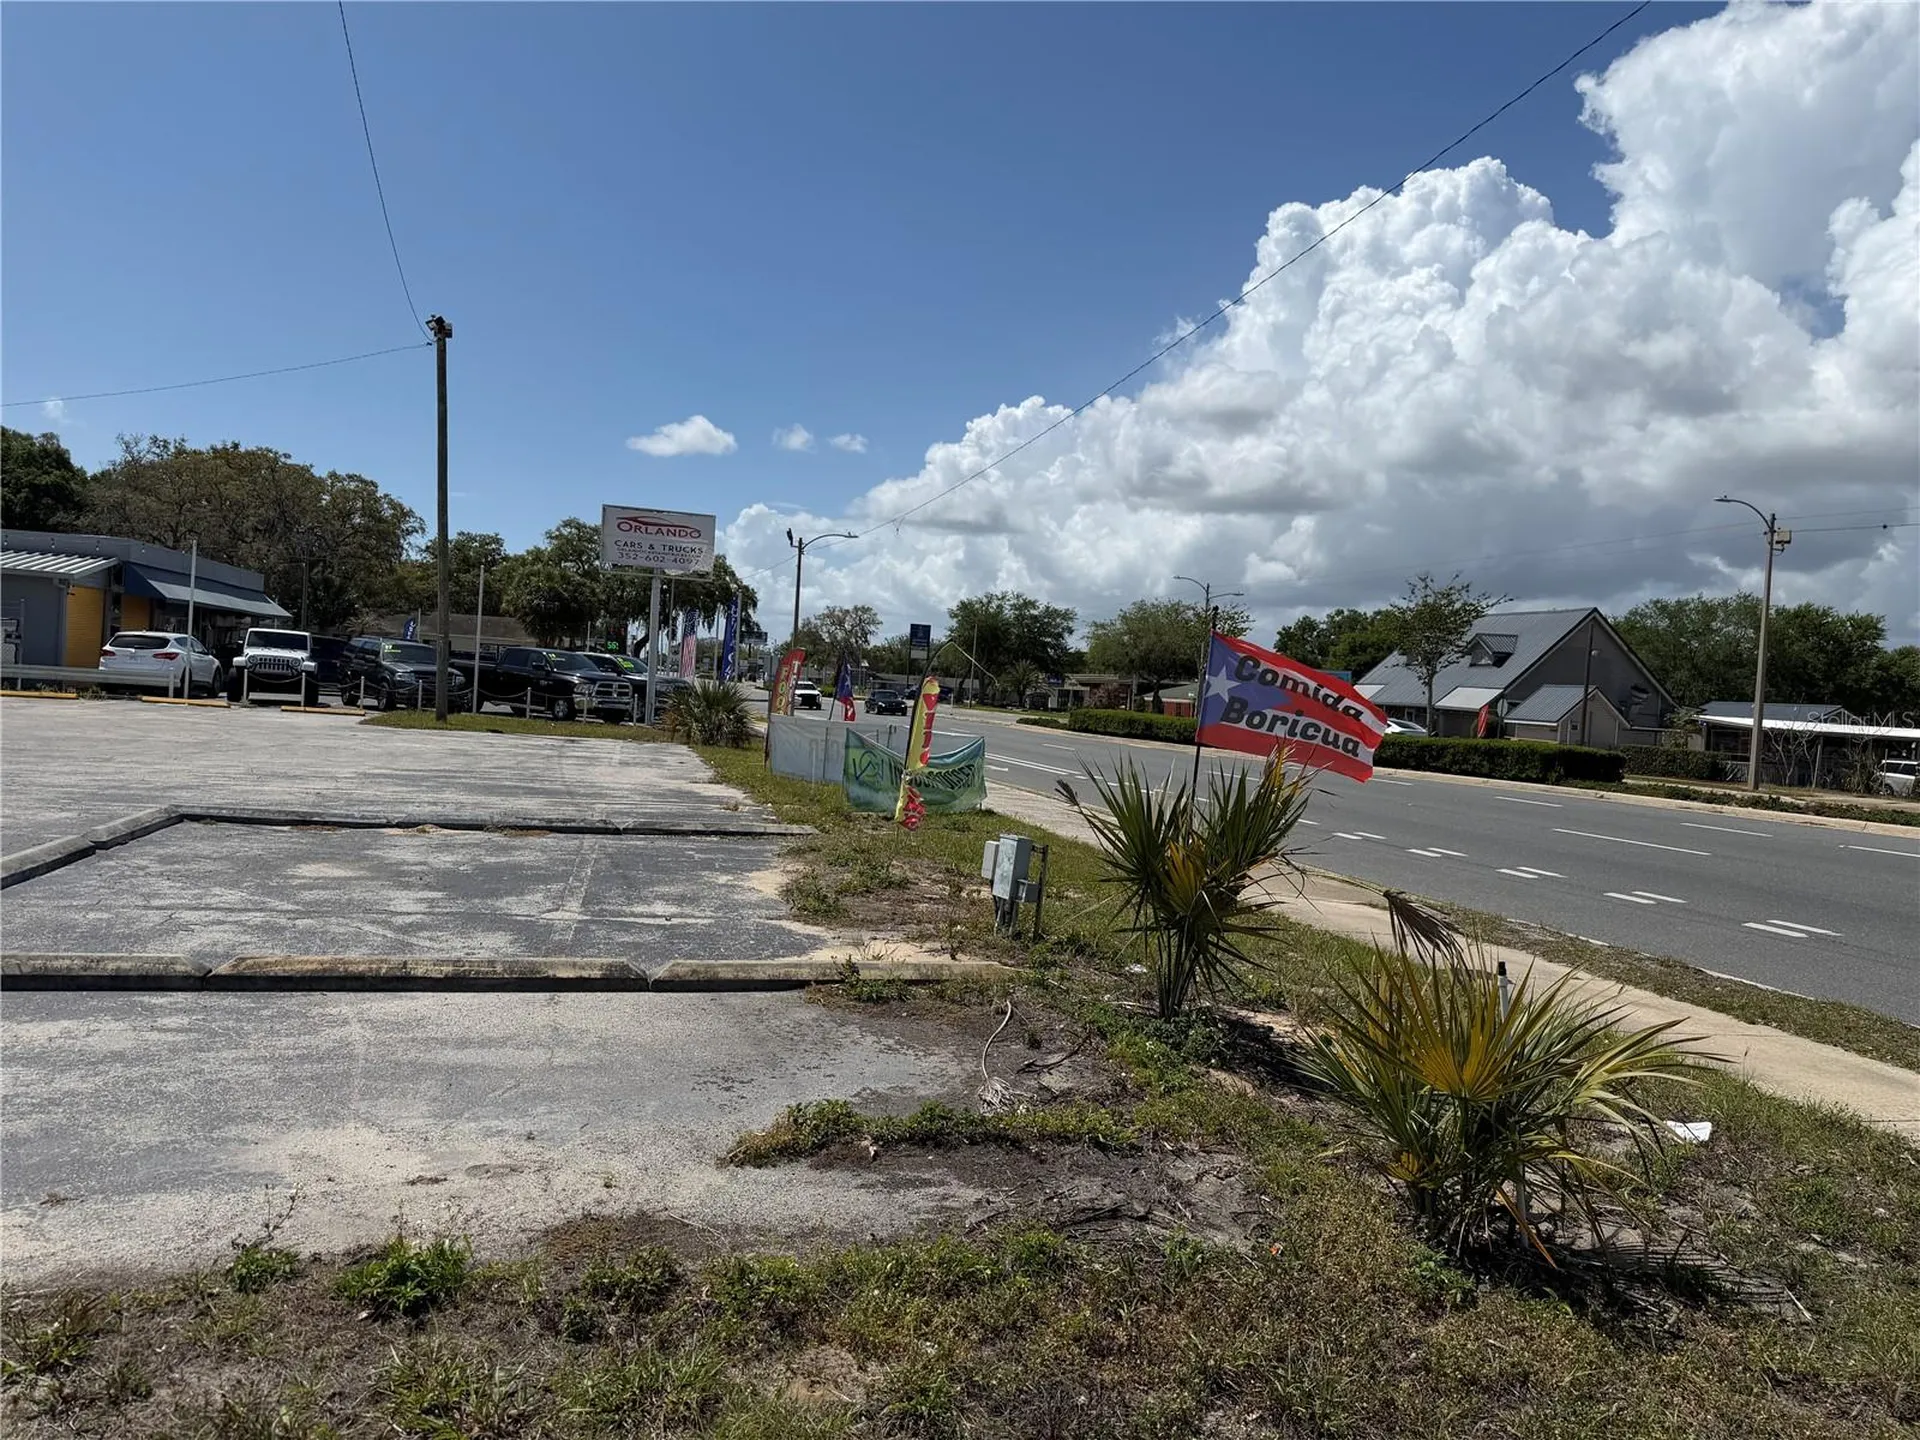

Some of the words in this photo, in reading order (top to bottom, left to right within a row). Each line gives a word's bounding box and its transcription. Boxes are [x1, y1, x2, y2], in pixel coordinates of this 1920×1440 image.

[614, 540, 643, 549] CARS
[662, 544, 704, 554] TRUCKS
[617, 521, 702, 538] ORLANDO
[1234, 655, 1364, 721] Comida
[1220, 695, 1361, 757] Boricua
